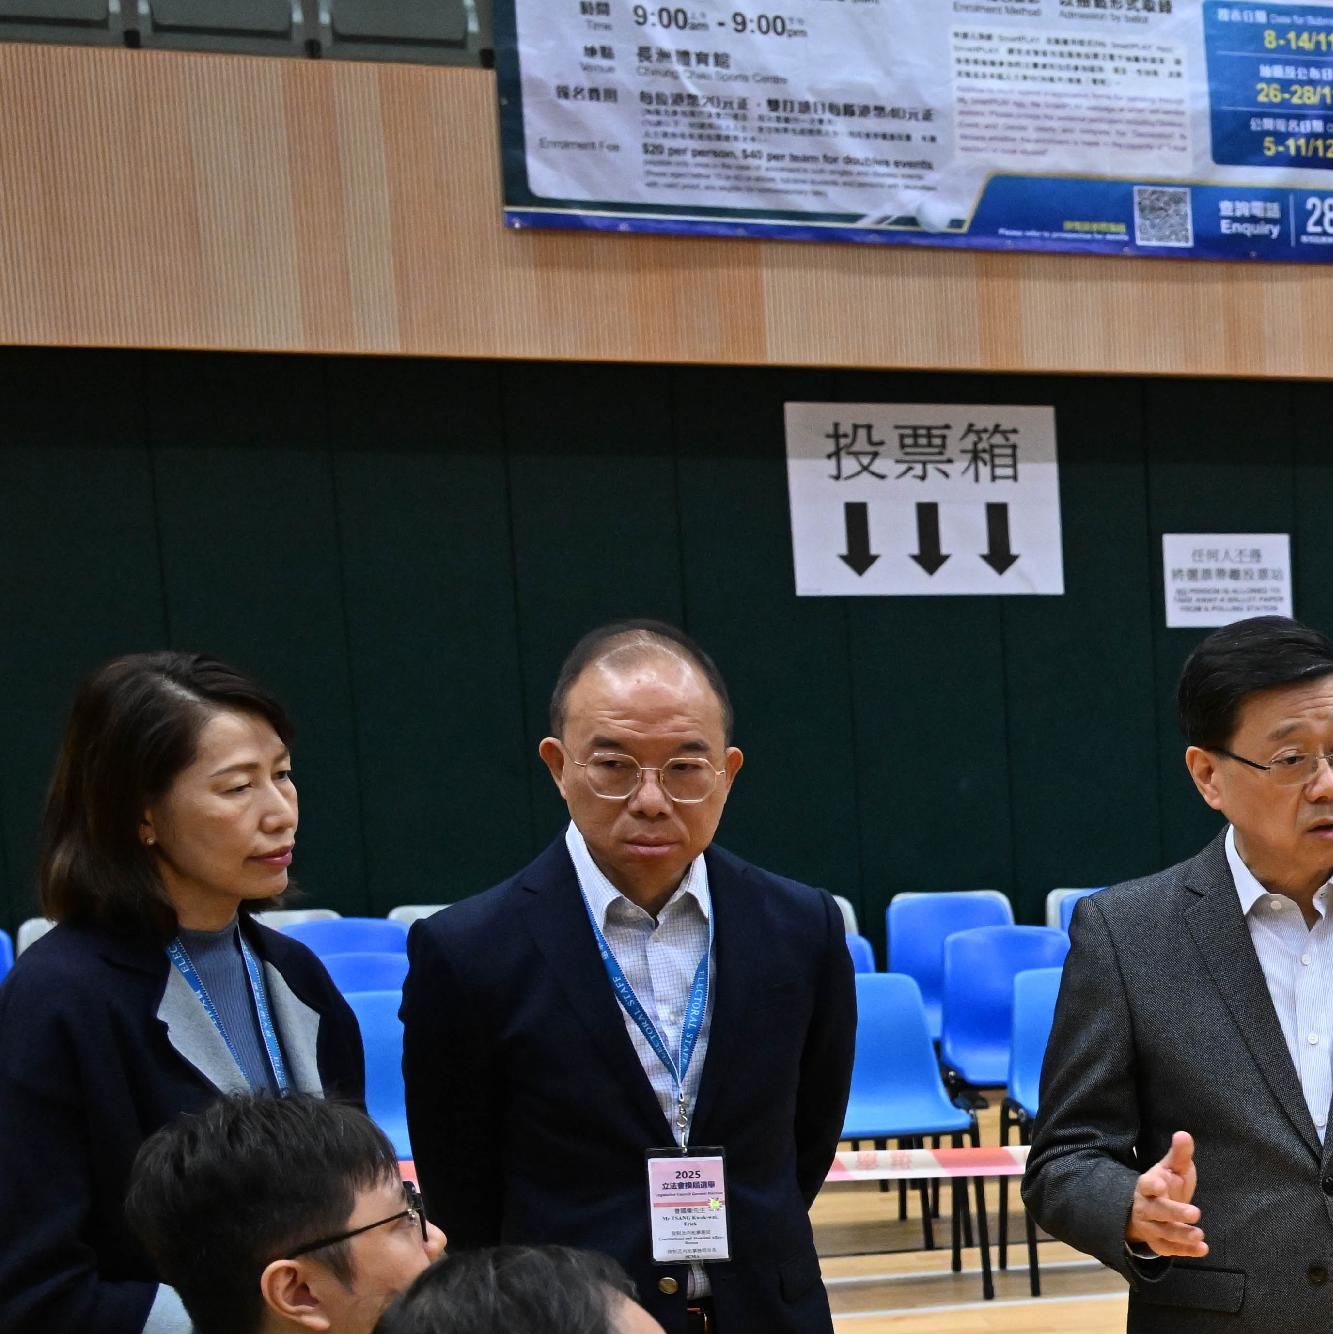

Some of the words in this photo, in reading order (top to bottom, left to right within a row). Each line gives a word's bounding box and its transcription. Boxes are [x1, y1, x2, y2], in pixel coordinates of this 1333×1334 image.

[634, 5, 688, 30] 9:00
[732, 12, 786, 37] 9:00
[1220, 220, 1280, 240] Enquiry
[824, 420, 1021, 484] 投票箱
[612, 976, 635, 1007] STAFF
[675, 1170, 701, 1179] 2025
